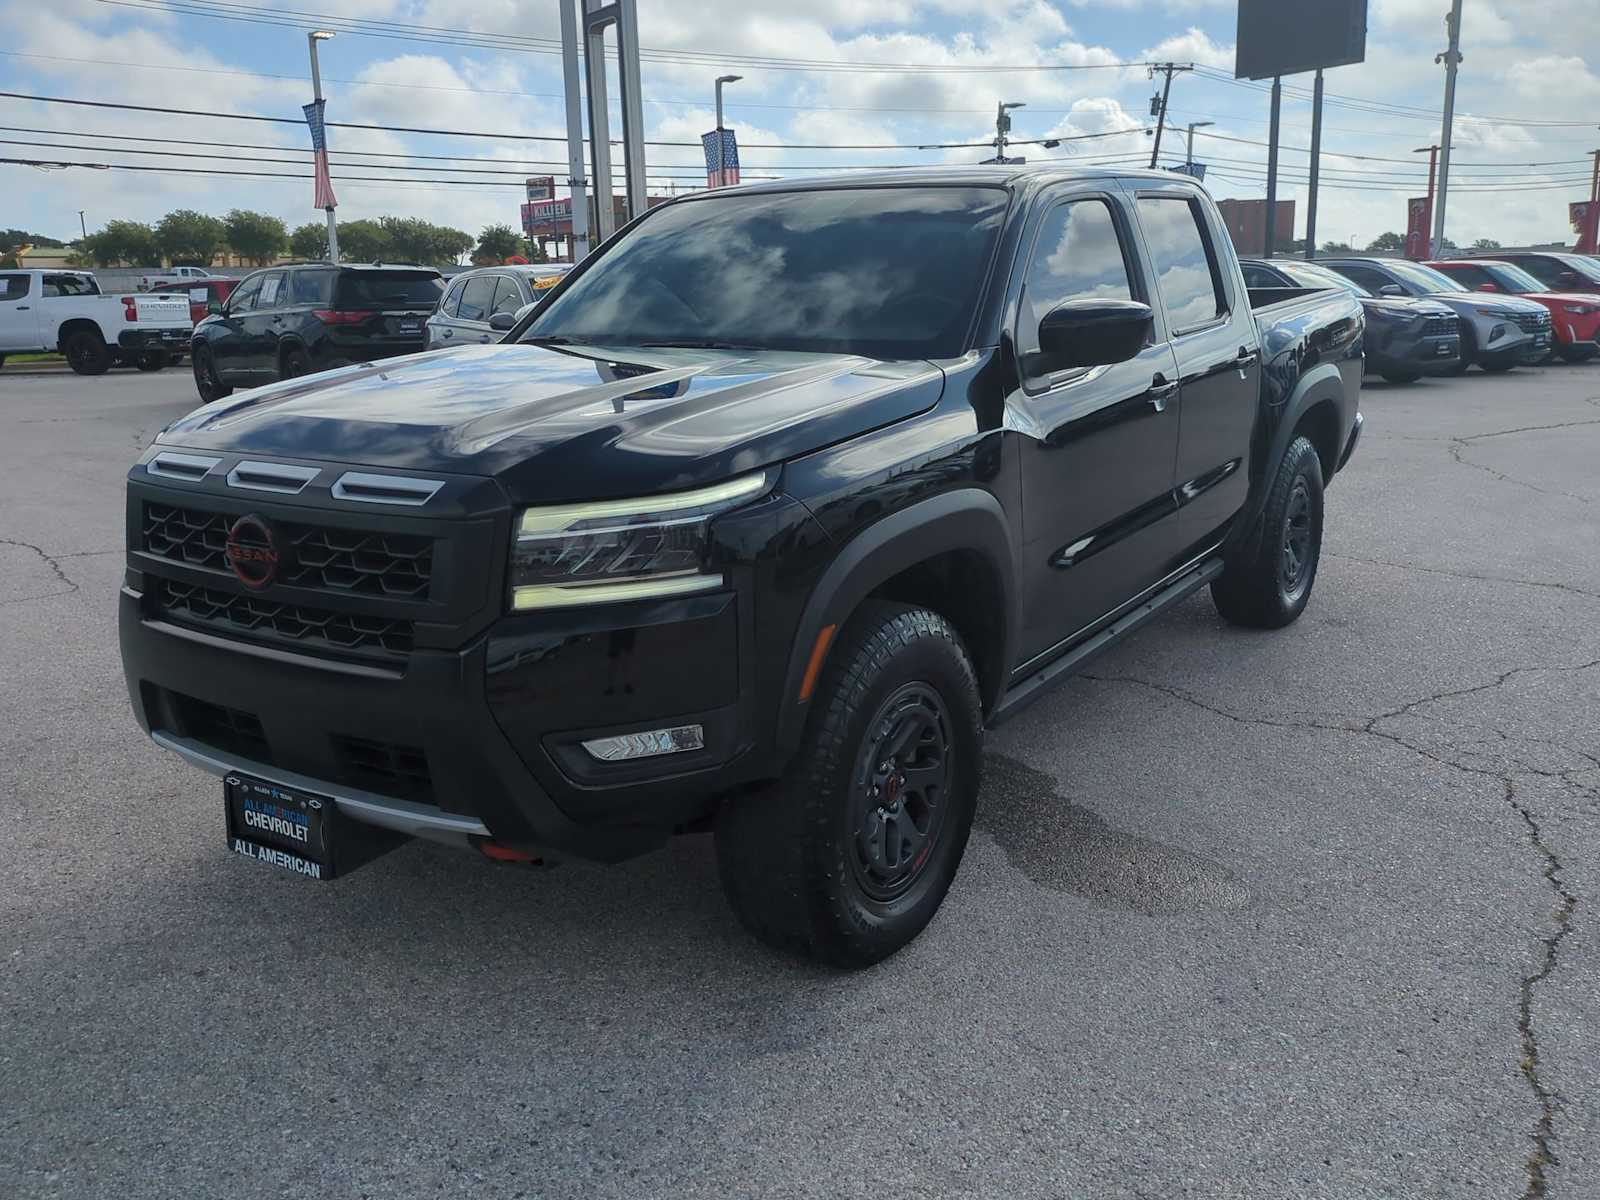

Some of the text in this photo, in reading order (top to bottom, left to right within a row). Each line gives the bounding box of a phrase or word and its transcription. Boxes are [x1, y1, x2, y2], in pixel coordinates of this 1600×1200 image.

[245, 809, 309, 843] CHEVROLET
[235, 839, 320, 879] ALL AMERICAN
